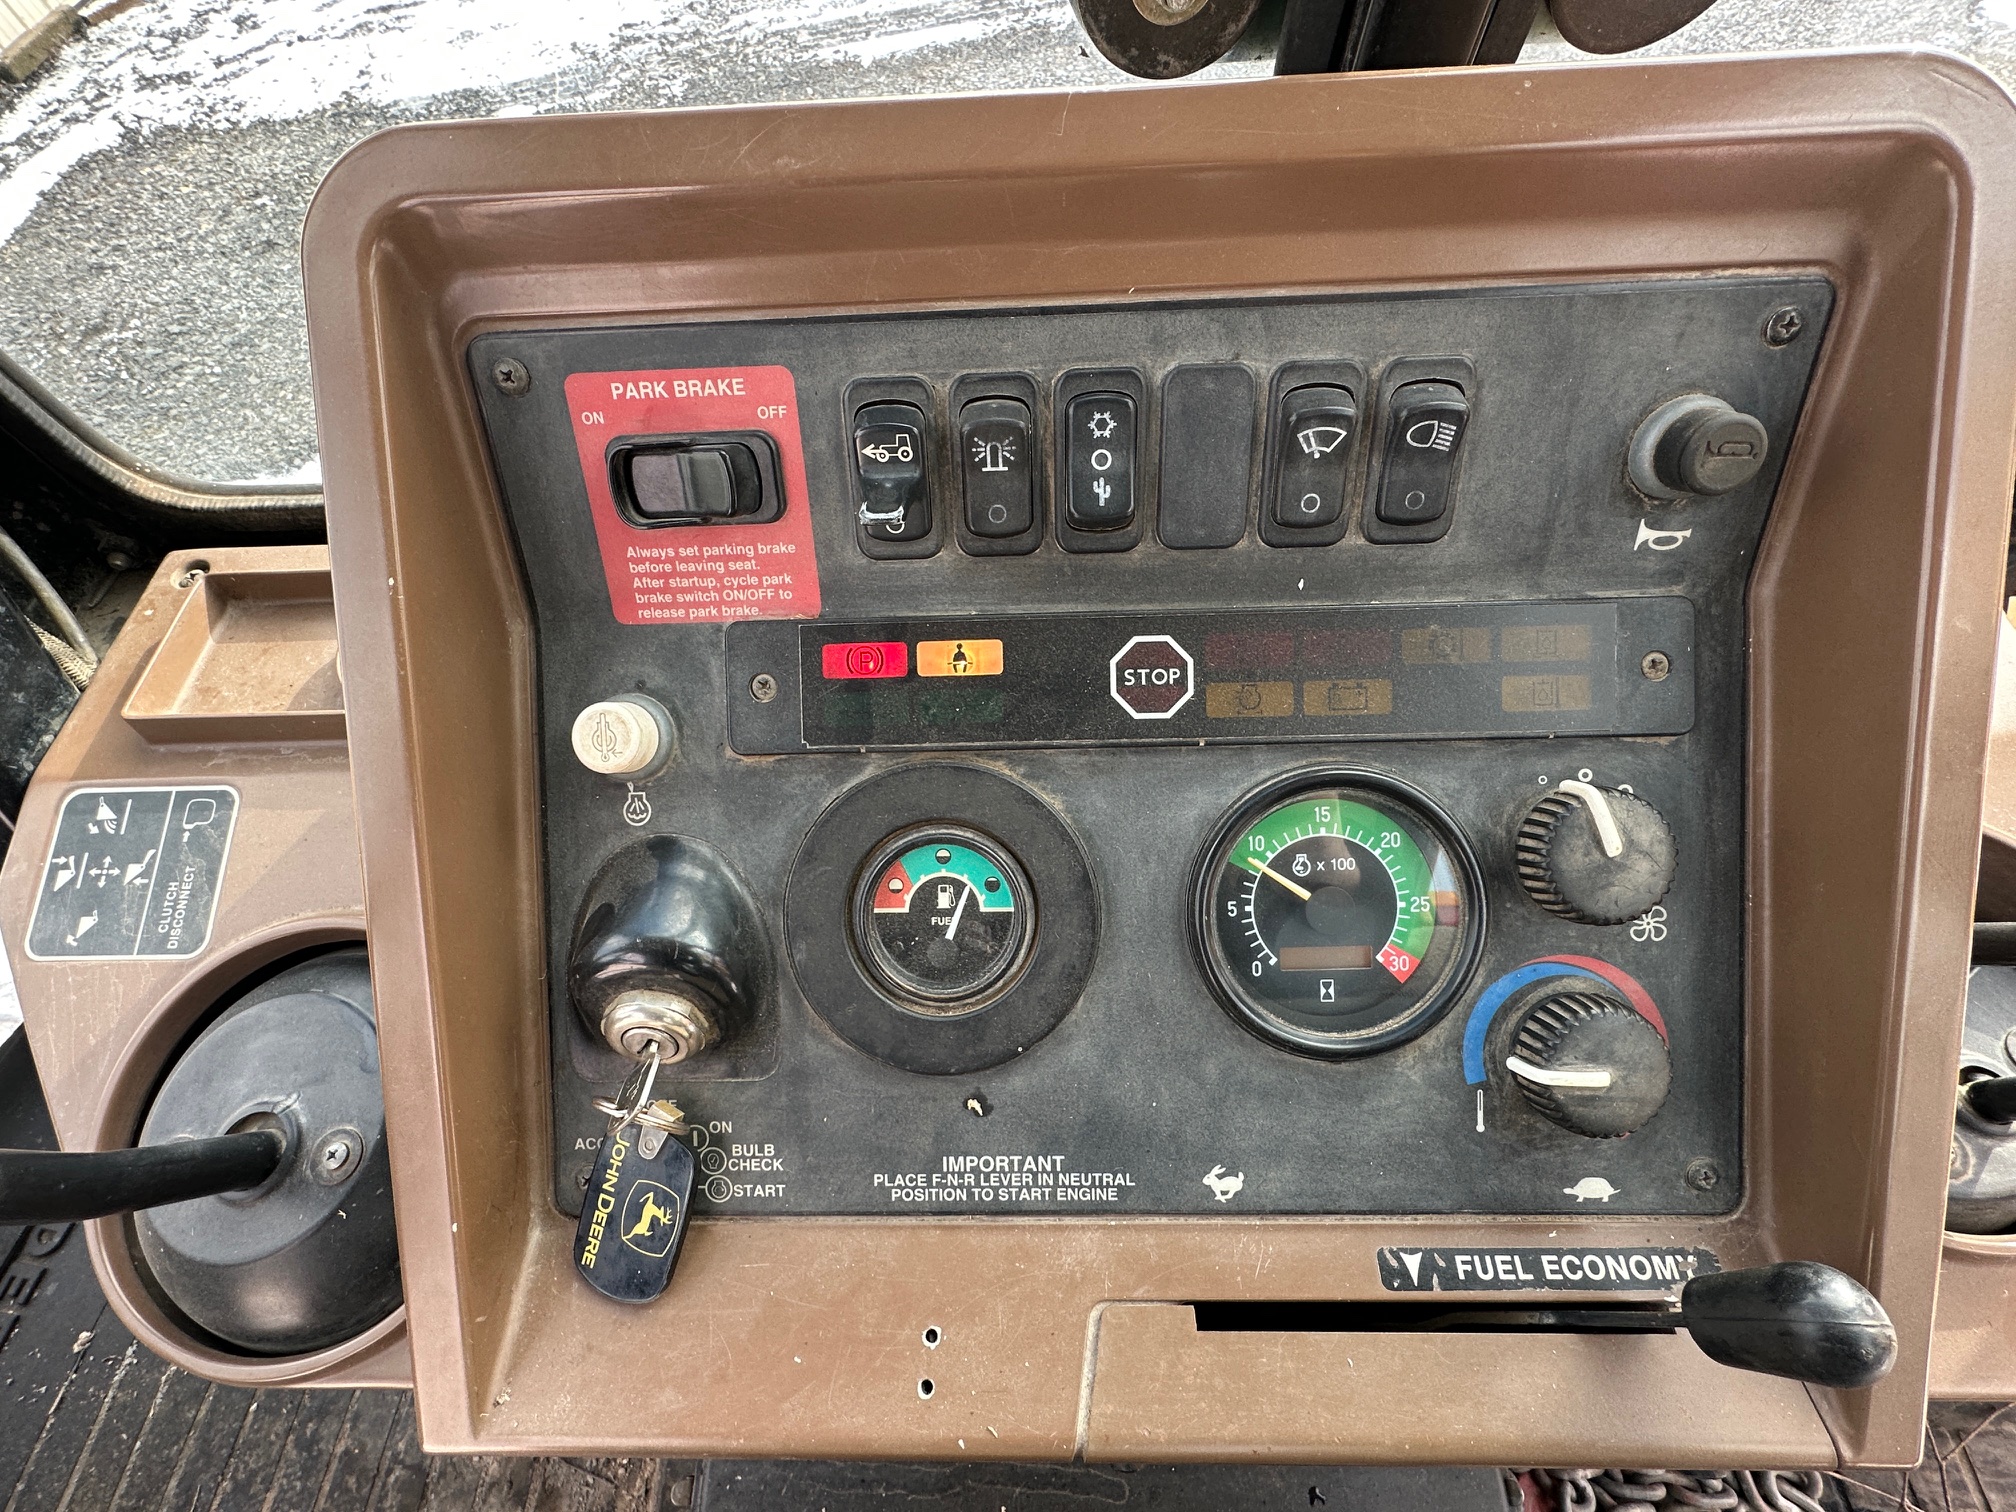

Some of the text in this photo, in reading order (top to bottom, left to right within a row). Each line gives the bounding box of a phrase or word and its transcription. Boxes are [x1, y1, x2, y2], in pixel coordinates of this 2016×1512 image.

[610, 378, 746, 400] PARK BRAKE
[581, 411, 604, 425] ON
[757, 405, 787, 419] OFF
[626, 542, 796, 560] Always set parking brake
[629, 559, 760, 574] before leaving seat.
[633, 573, 792, 590] After startup, cycle park
[635, 588, 793, 604] brake switch ON/OFF to
[638, 605, 763, 620] release park brake.
[1124, 669, 1180, 687] STOP
[1314, 806, 1331, 823] 15
[1248, 835, 1265, 851] 10
[1380, 832, 1401, 848] 20
[1331, 858, 1356, 870] 100
[158, 882, 179, 933] CLUTCH
[167, 866, 196, 949] DISCONNECT
[1227, 901, 1238, 917] 5
[1410, 896, 1431, 913] 25
[931, 917, 954, 926] FUE
[1251, 961, 1262, 977] 0
[1389, 955, 1410, 972] 30
[709, 1121, 732, 1134] ON
[732, 1144, 775, 1157] BULB
[728, 1158, 784, 1171] CHECK
[942, 1155, 1065, 1172] IMPORTANT
[874, 1173, 1136, 1187] PLACE F-N-R LEVER IN NEUTRAL
[734, 1184, 786, 1197] START
[891, 1188, 1118, 1201] POSITION TO START ENGINE
[581, 1131, 630, 1269] JOHN DEERE
[1454, 1255, 1534, 1281] FUEL
